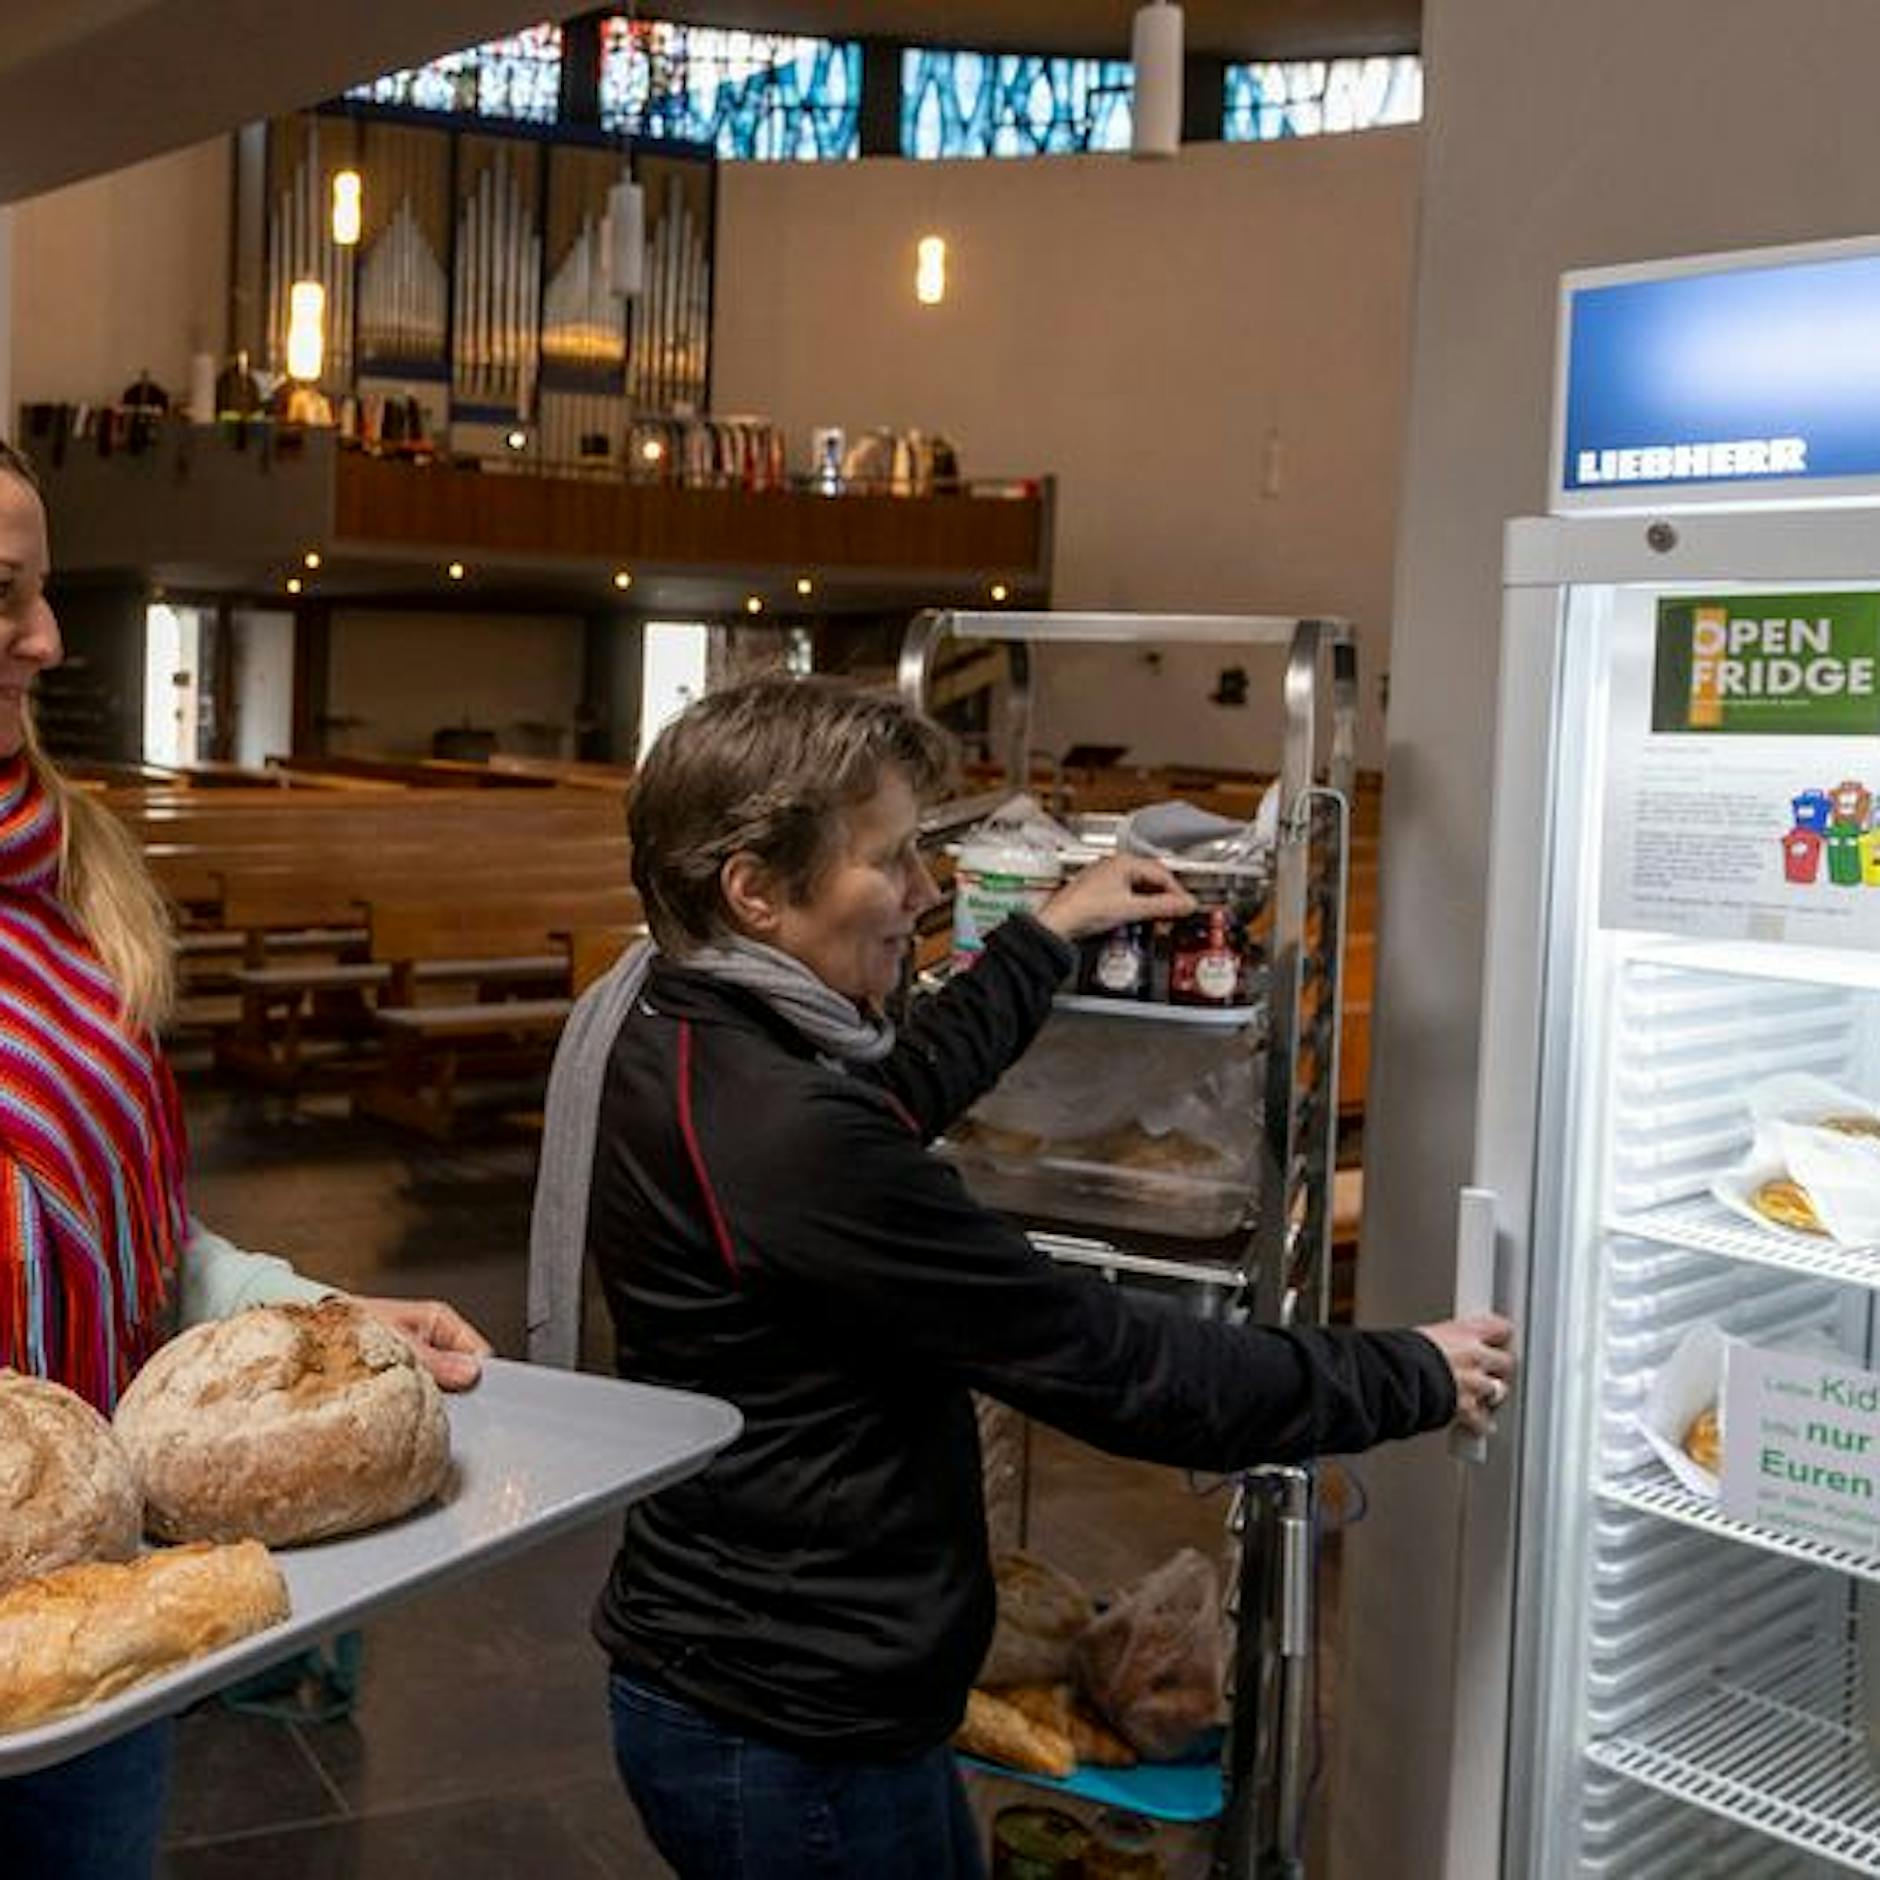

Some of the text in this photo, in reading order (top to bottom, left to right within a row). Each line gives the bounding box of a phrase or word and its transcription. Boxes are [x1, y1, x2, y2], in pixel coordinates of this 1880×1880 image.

[1578, 437, 1807, 484] LIEBHERR
[1692, 618, 1832, 656] OPEN
[1690, 657, 1875, 696] FRIDGE
[1806, 1420, 1873, 1452] nur
[1760, 1447, 1874, 1498] Euren
